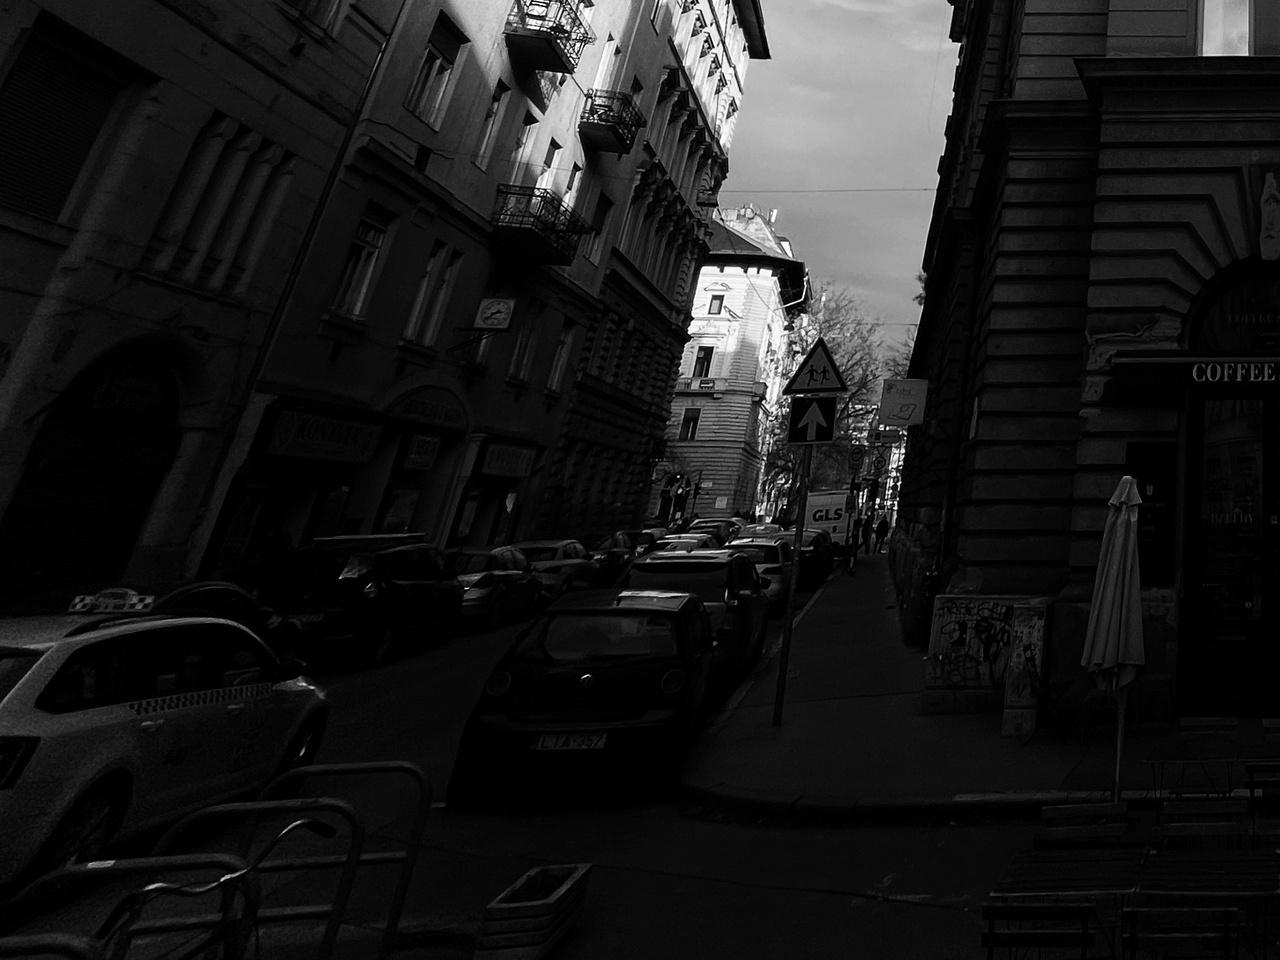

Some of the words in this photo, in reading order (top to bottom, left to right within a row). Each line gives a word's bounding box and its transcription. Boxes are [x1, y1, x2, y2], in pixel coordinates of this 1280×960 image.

[1228, 313, 1273, 324] COFFEE
[1192, 362, 1276, 383] COFFEE
[812, 507, 843, 522] GLS
